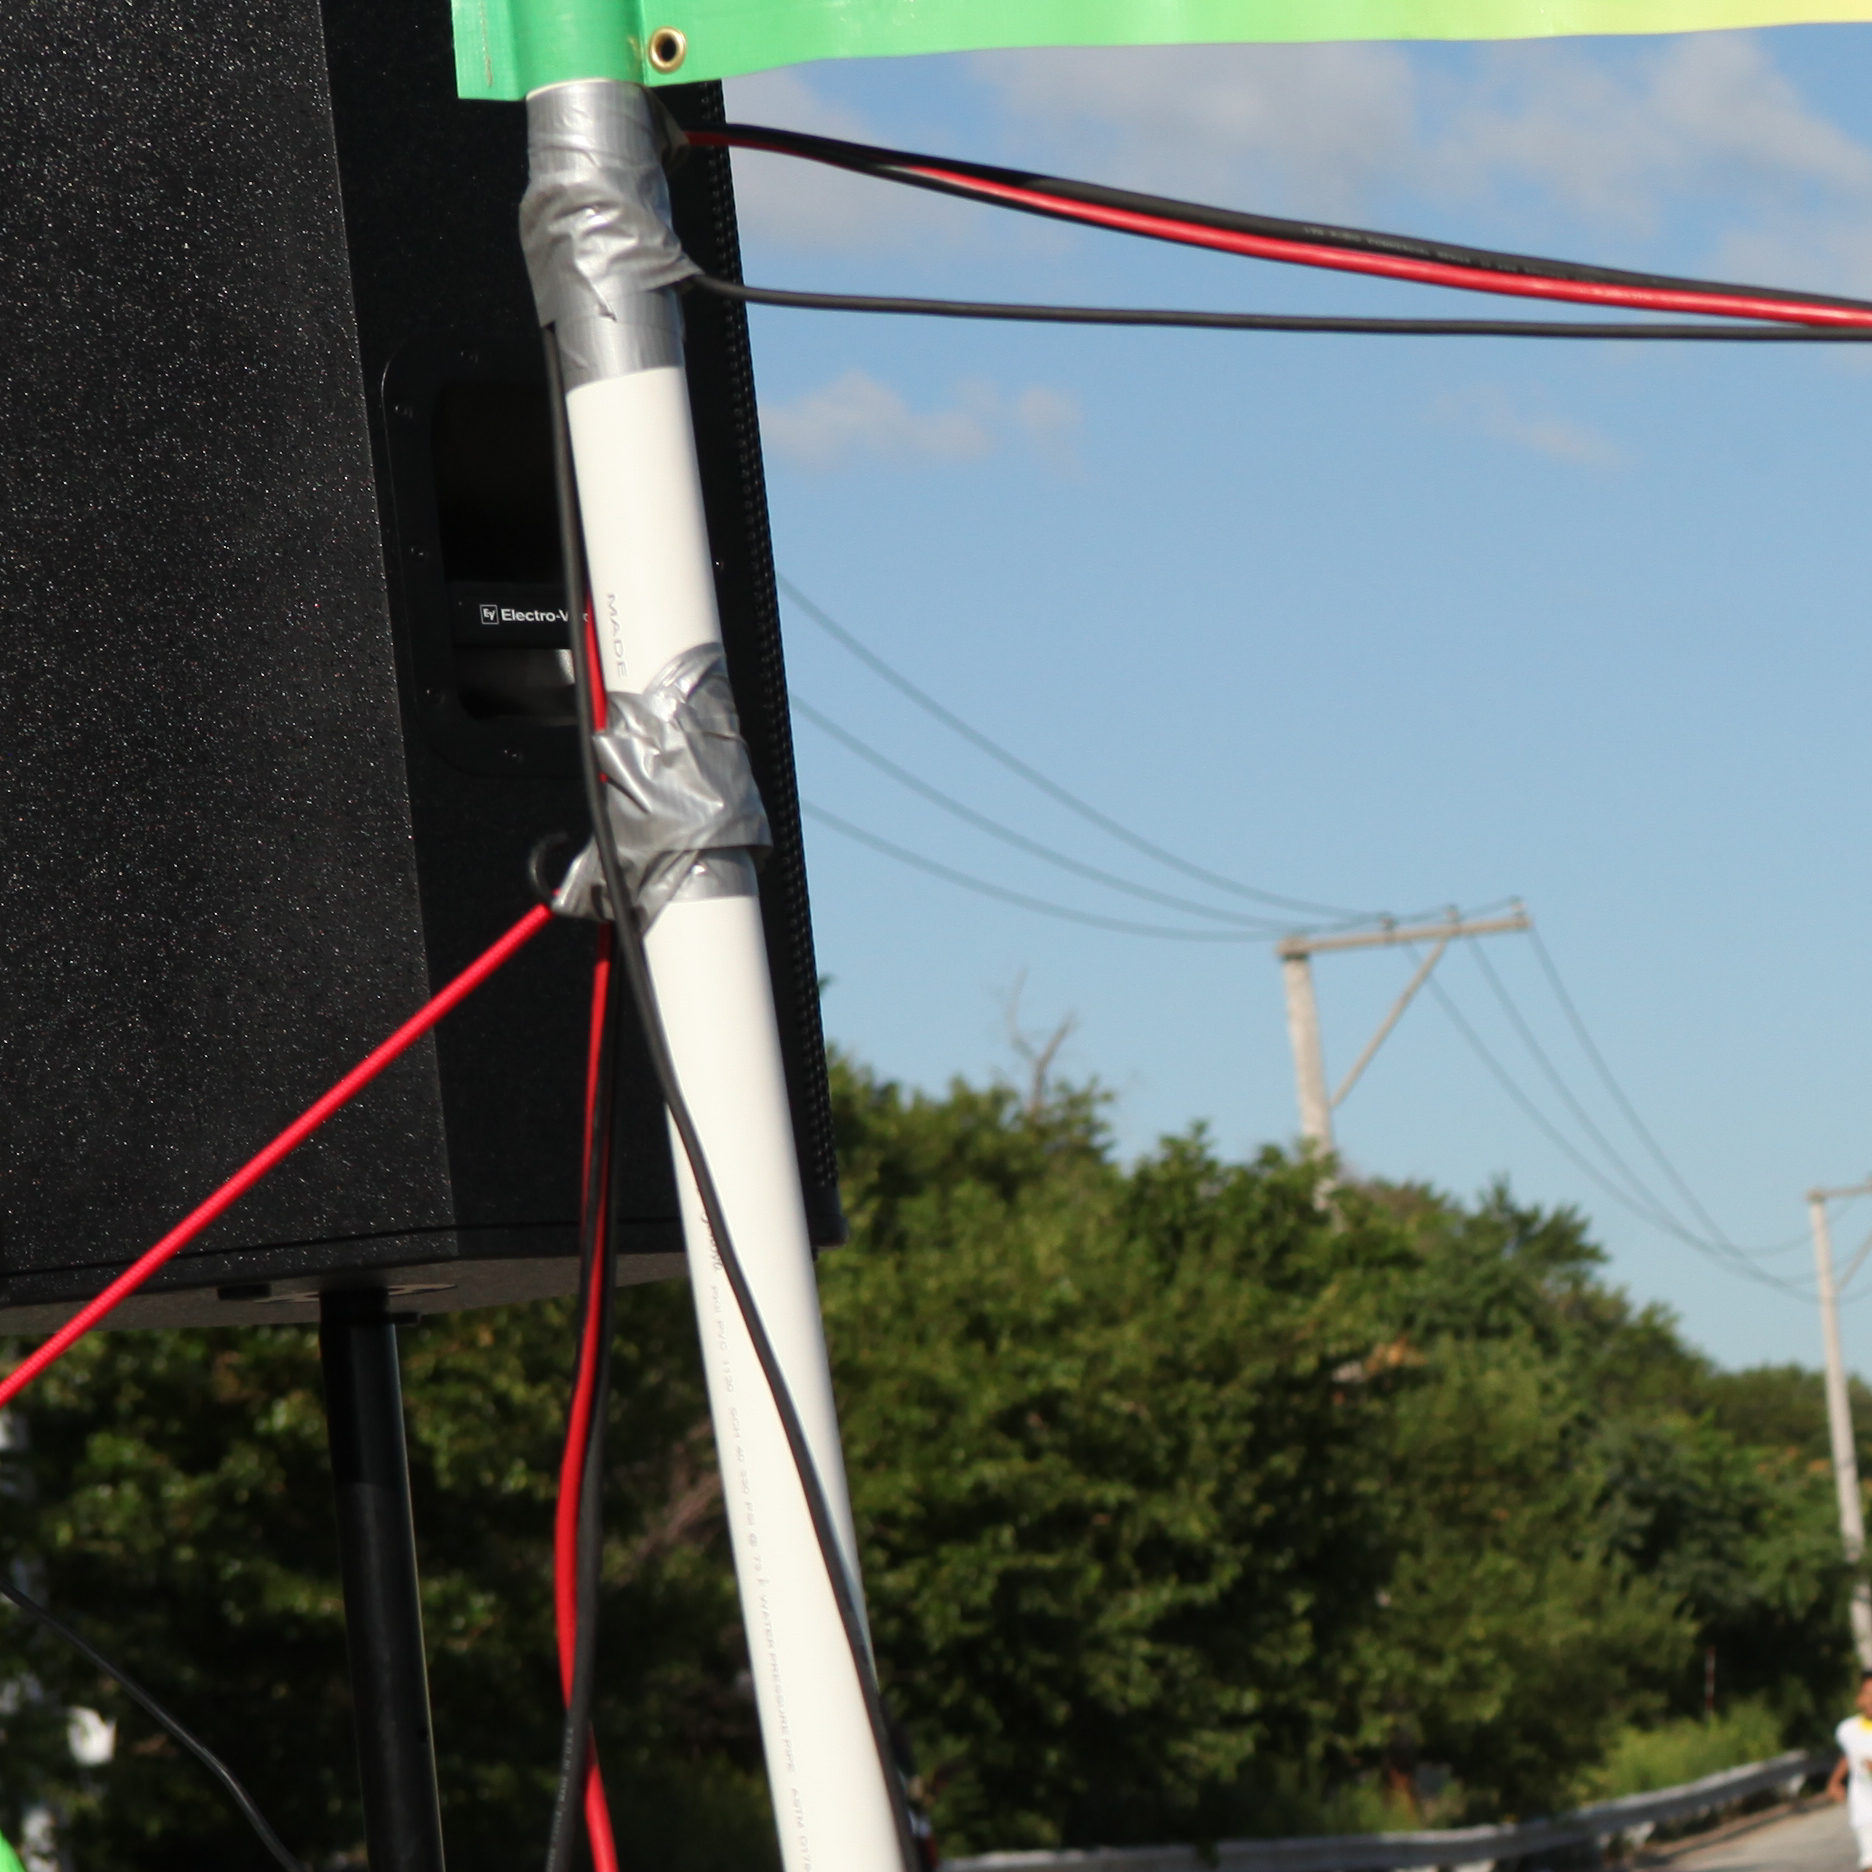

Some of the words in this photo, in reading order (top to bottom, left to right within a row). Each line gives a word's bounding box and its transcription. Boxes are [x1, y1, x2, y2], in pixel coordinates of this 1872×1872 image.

[501, 608, 589, 622] Electro-V
[607, 593, 629, 679] MADE
[759, 1594, 775, 1648] WATER
[768, 1652, 790, 1734] PRESSURE
[782, 1739, 796, 1772] PIPE
[790, 1787, 806, 1828] ASTM
